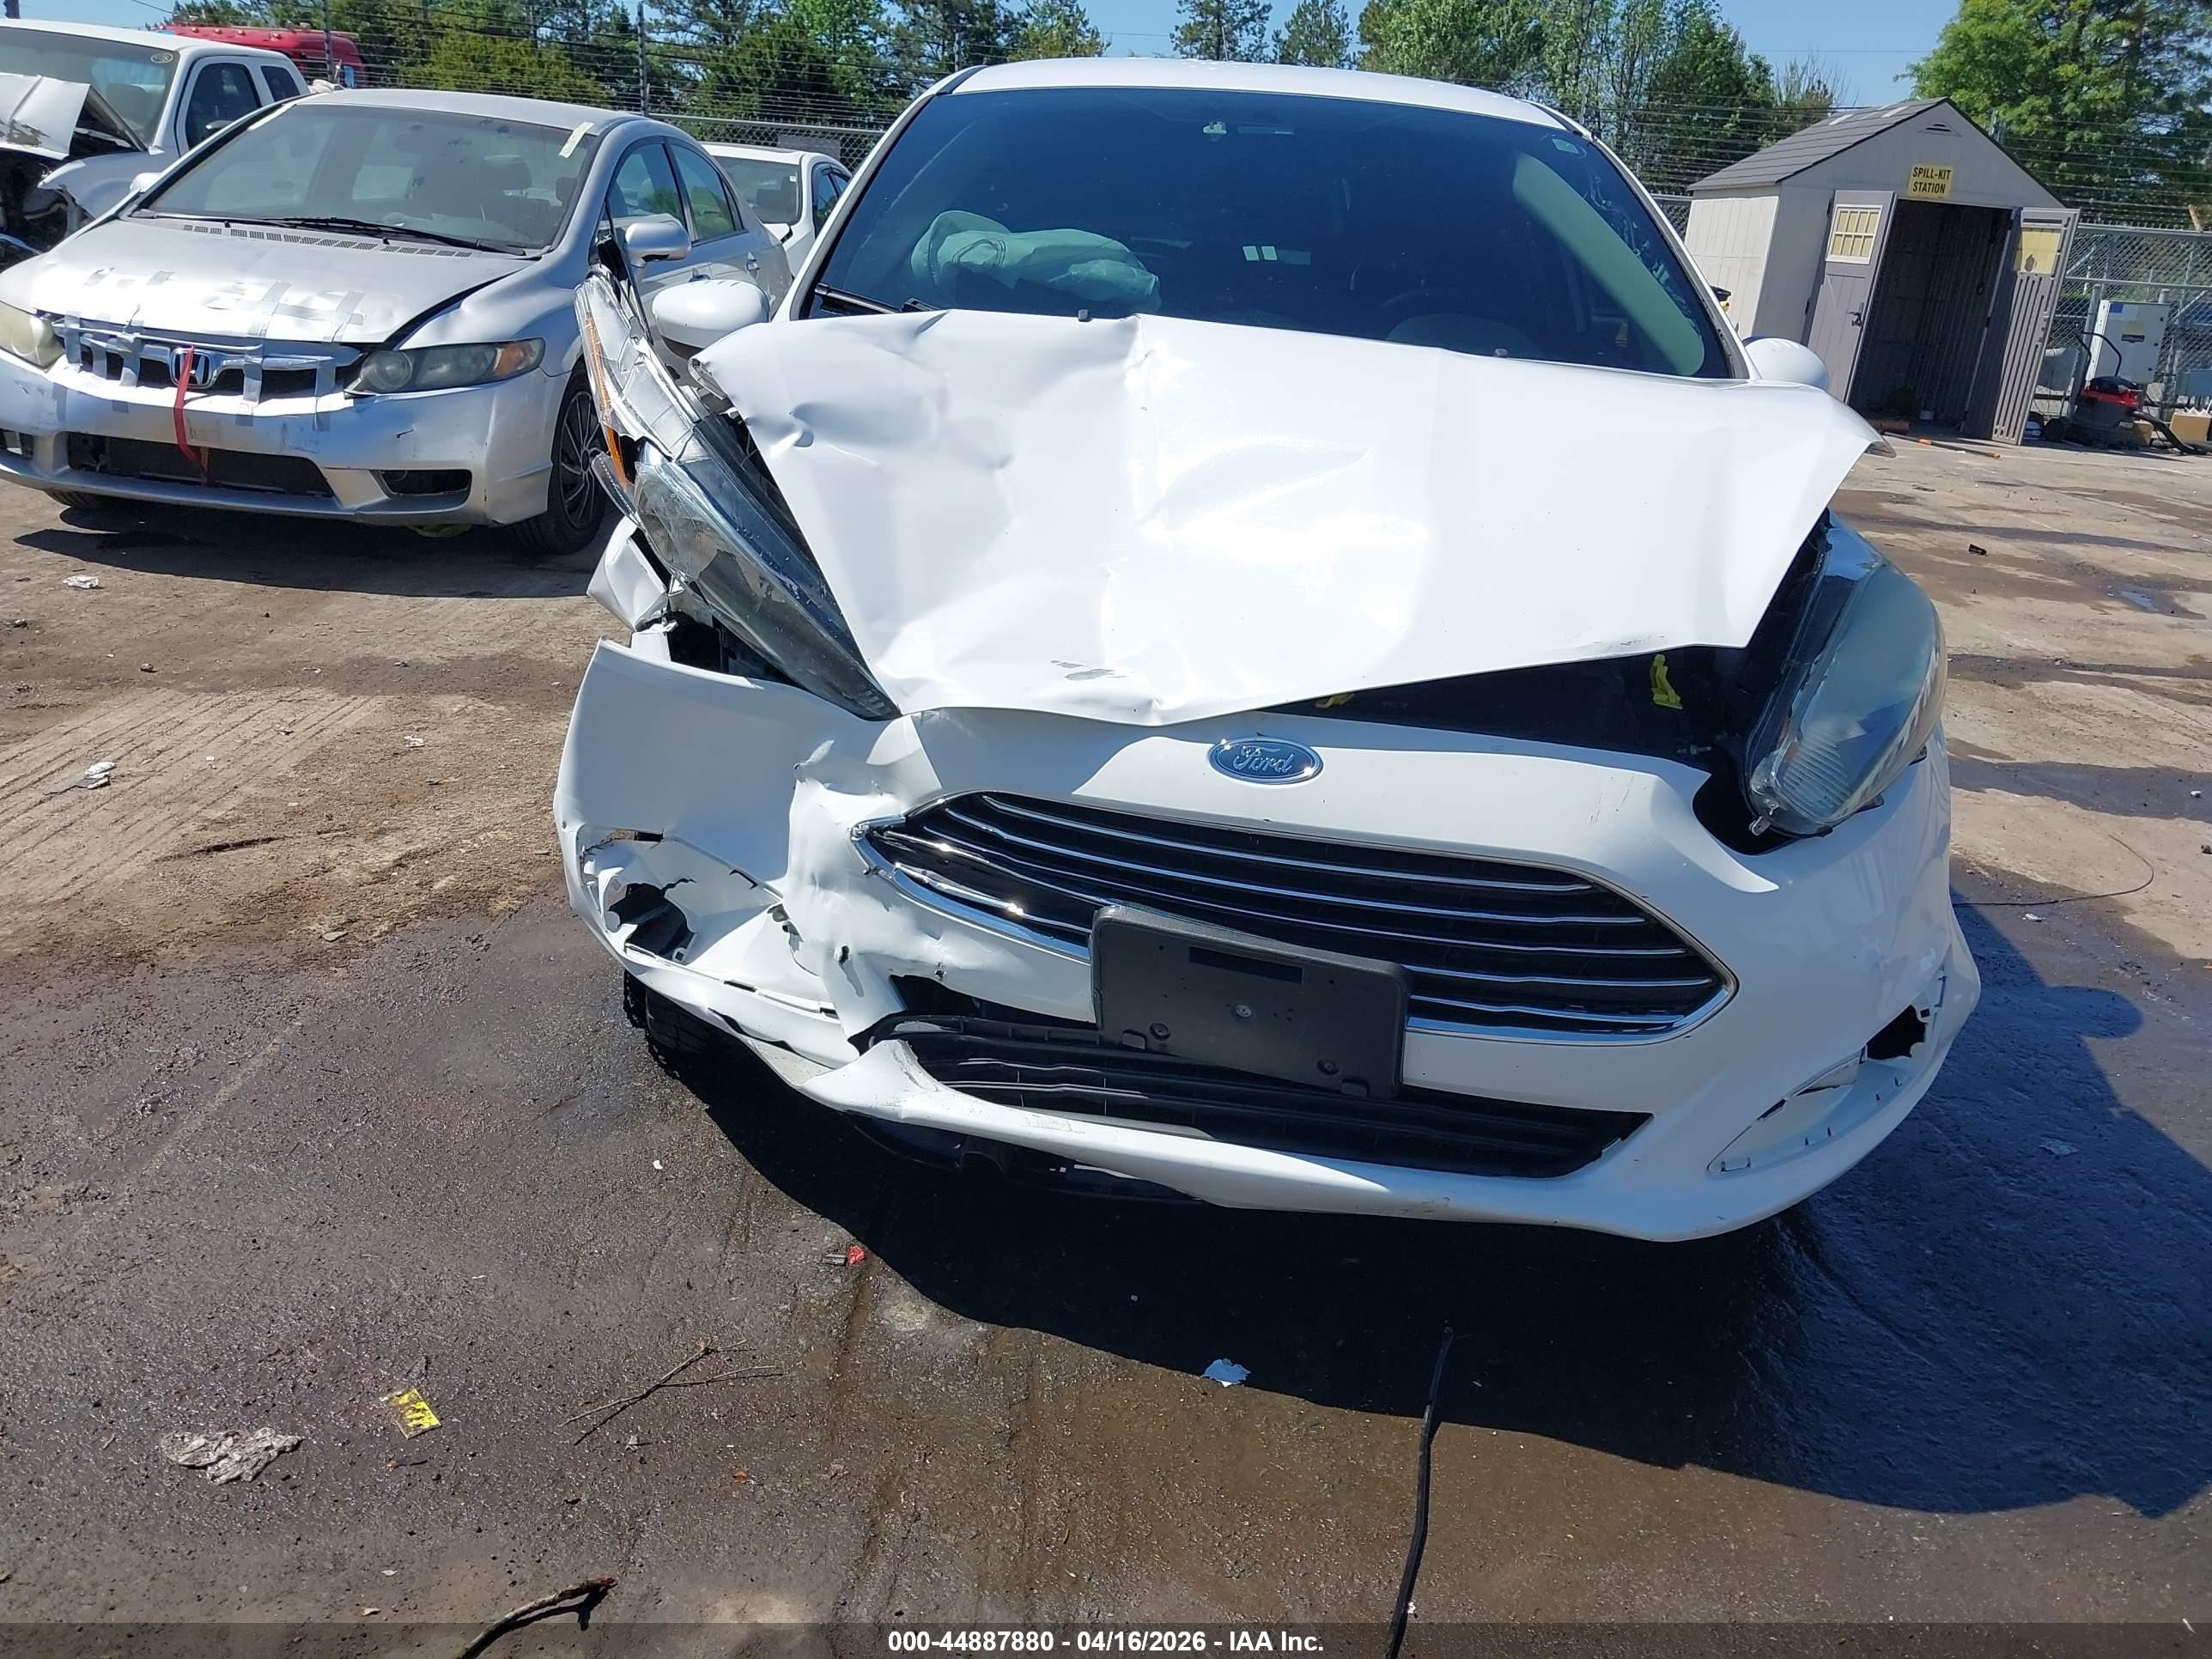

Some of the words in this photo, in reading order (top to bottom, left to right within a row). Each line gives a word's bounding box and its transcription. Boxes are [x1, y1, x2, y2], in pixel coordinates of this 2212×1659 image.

[1912, 167, 1952, 180] SPILL-KIT
[1912, 181, 1946, 194] STATION
[1232, 744, 1294, 773] Ford
